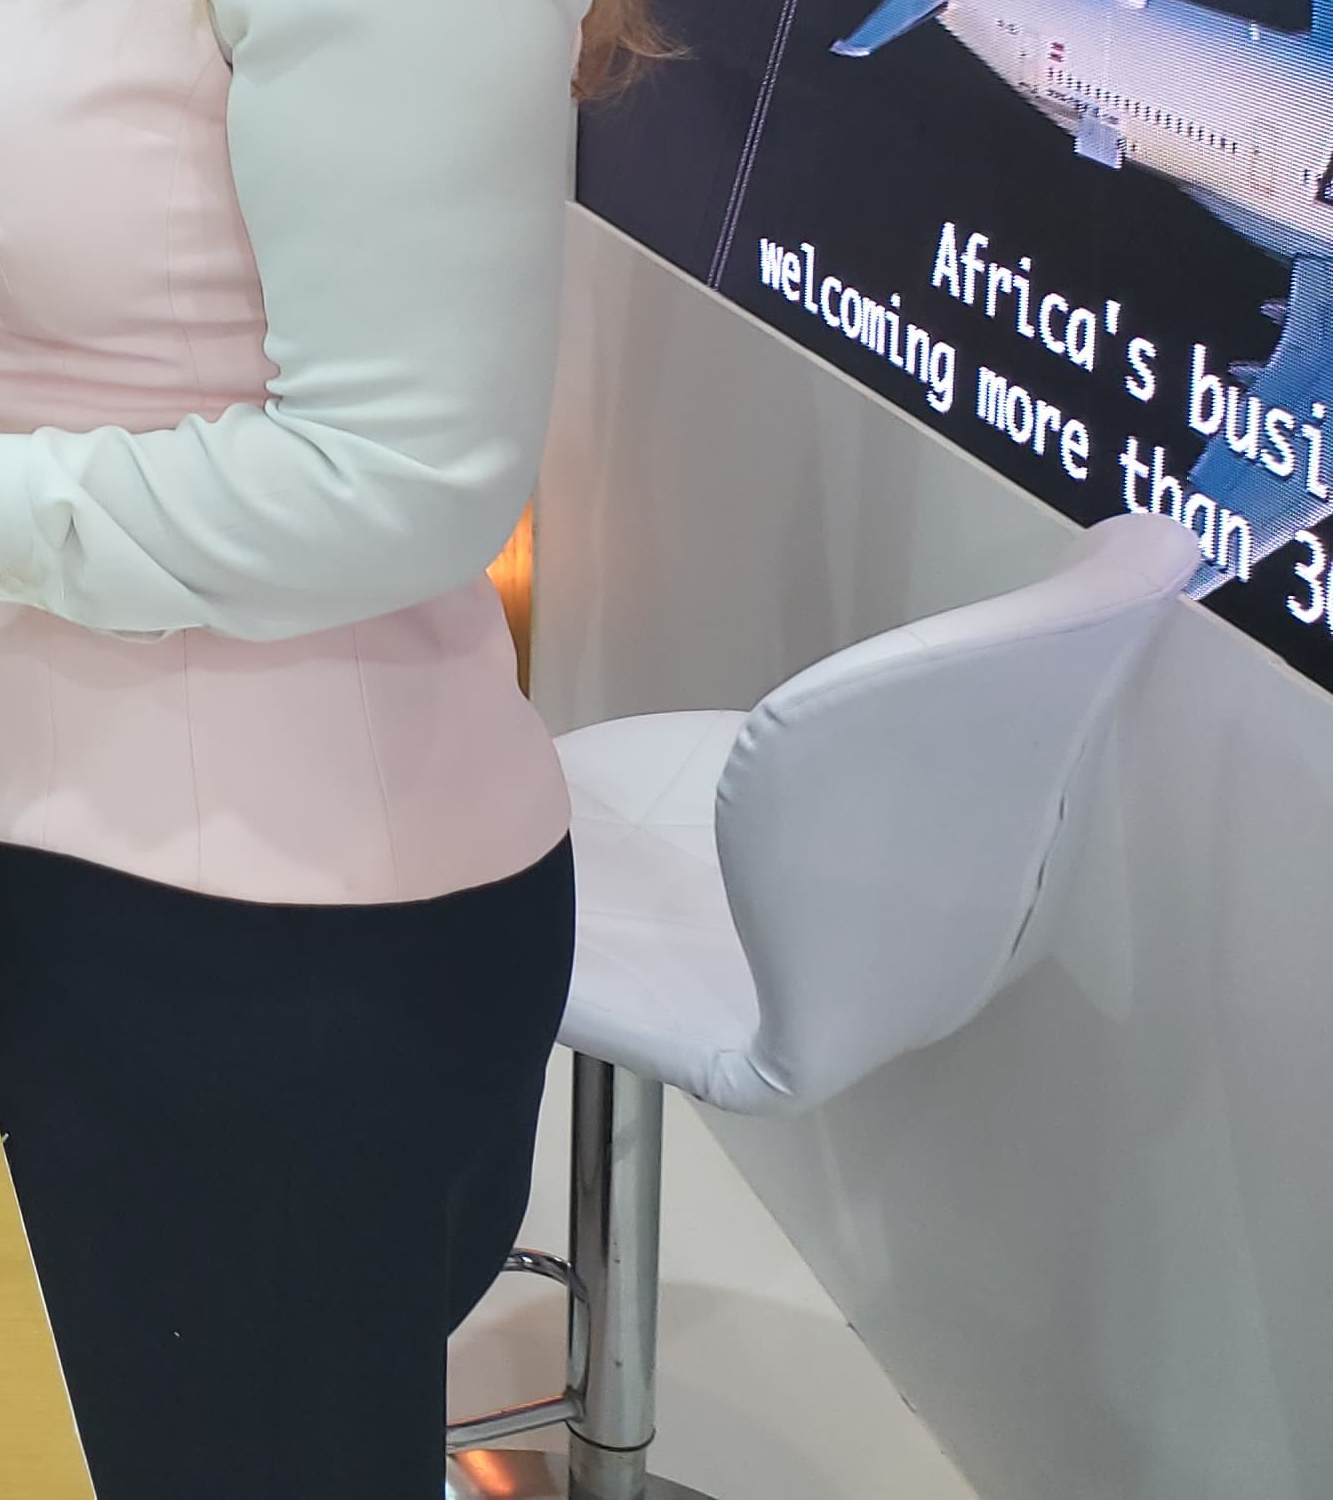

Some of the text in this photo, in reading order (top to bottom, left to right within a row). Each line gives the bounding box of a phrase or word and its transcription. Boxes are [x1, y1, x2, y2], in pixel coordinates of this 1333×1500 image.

[758, 237, 1333, 638] welcoming more than 3
[932, 221, 1333, 500] Africa's busi
